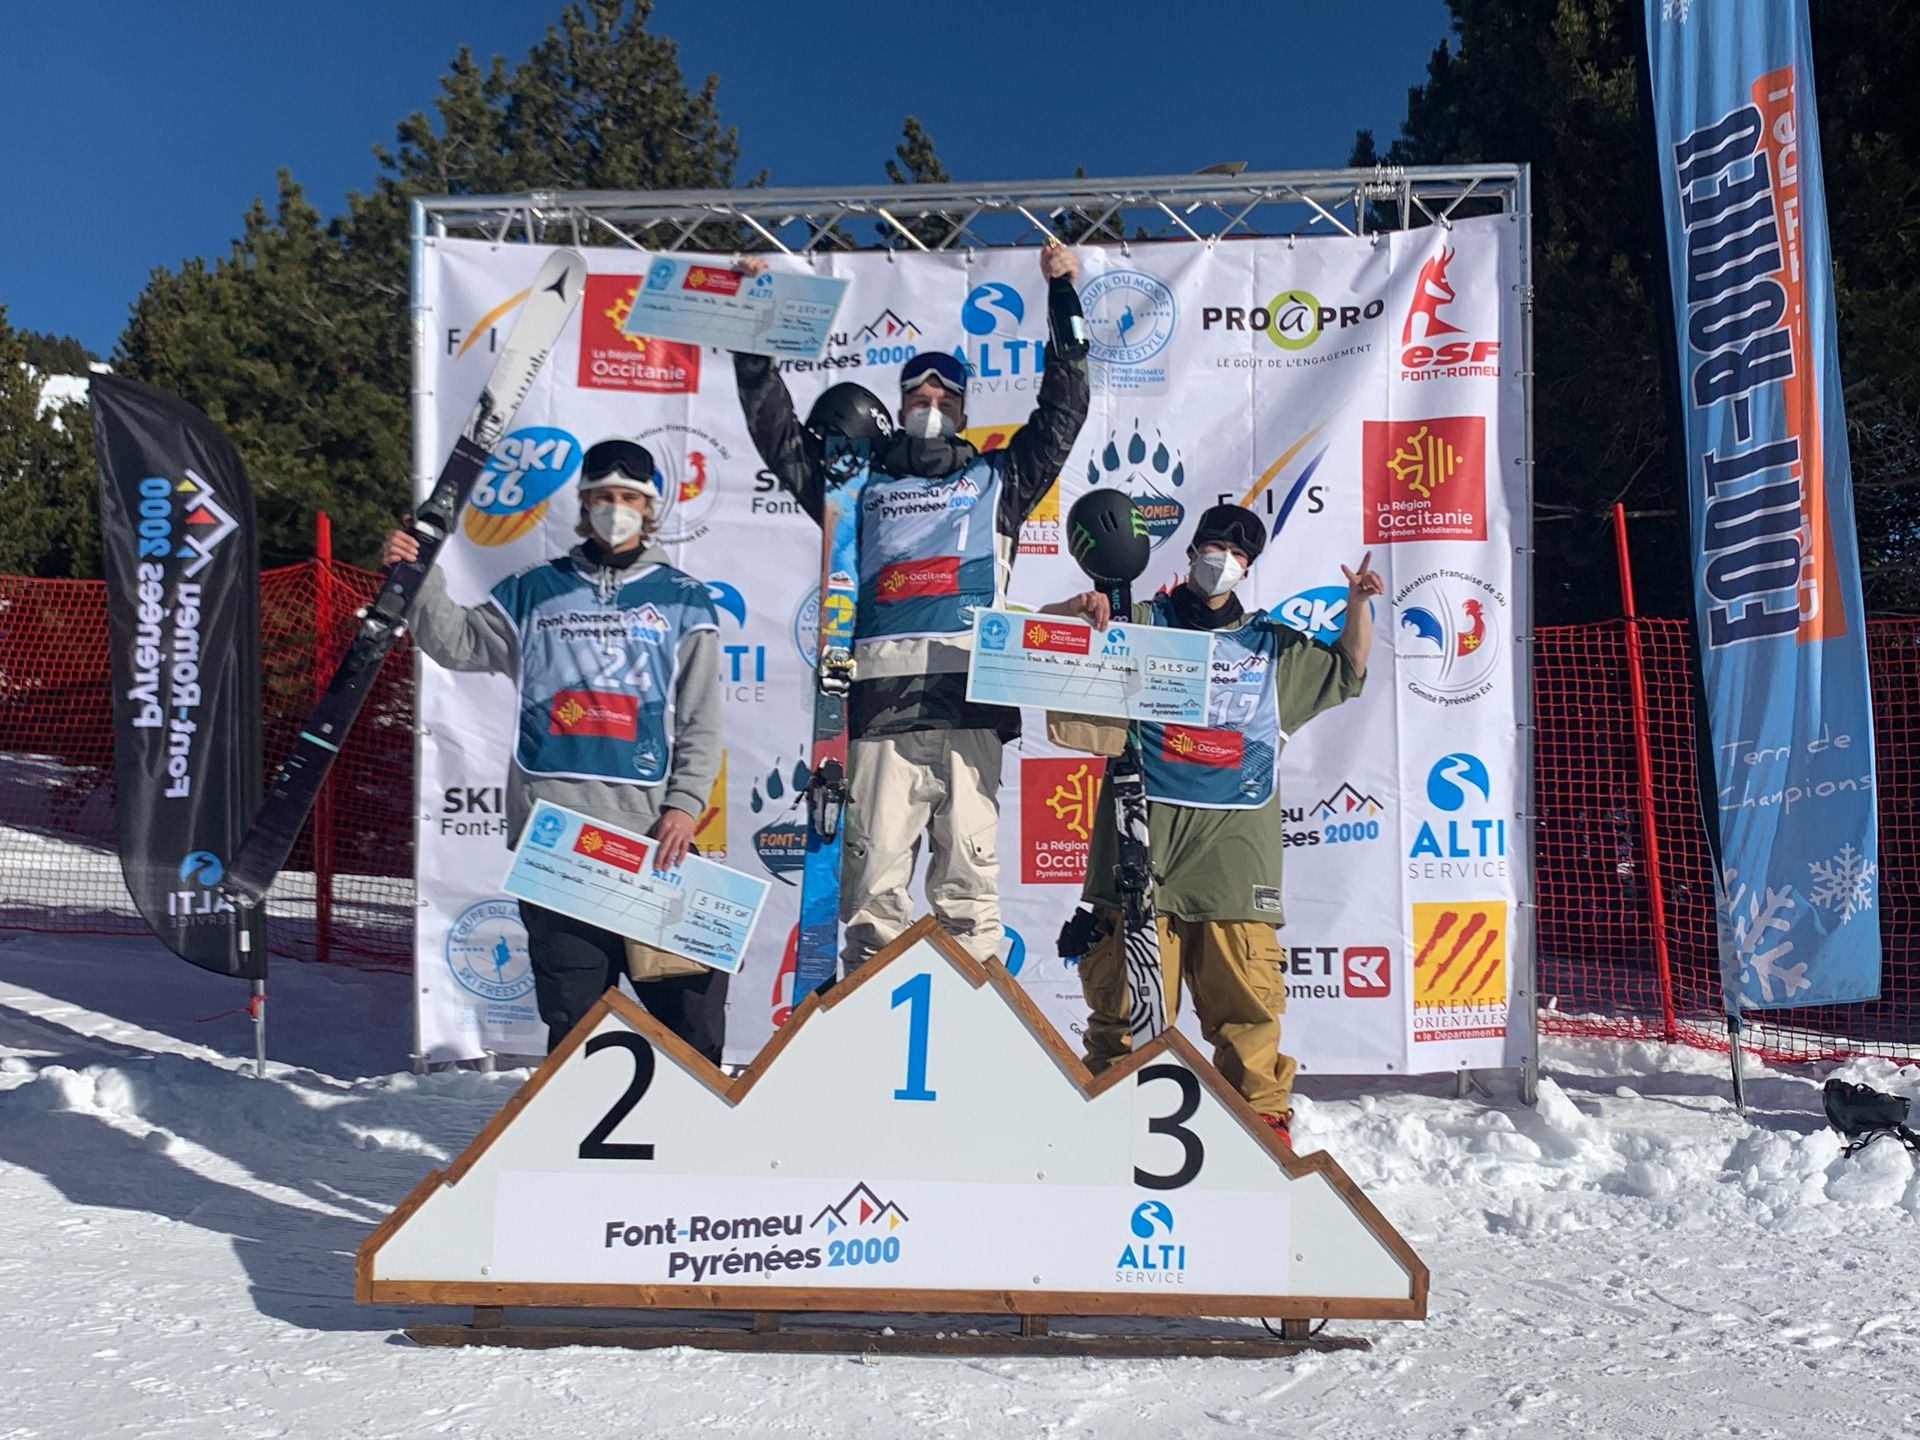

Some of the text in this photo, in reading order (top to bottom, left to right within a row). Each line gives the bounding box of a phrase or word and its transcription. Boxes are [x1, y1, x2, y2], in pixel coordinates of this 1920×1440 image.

[1202, 307, 1271, 331] PRO
[1316, 299, 1385, 331] PRO
[1217, 359, 1230, 368] LE
[1267, 359, 1283, 368] DE
[1286, 344, 1372, 368] L'ENGAGEMENT
[590, 360, 687, 381] Occitanie
[1401, 366, 1501, 382] FONT-ROMEU
[493, 438, 572, 473] SKI
[472, 471, 524, 508] 66
[1377, 499, 1431, 513] La Région
[1378, 507, 1474, 529] Occitanie
[951, 512, 970, 552] 1
[1391, 569, 1508, 608] Fédération Française de Ski
[1050, 633, 1087, 644] Occitanie
[1101, 645, 1130, 657] ALTI
[593, 646, 652, 692] 24
[1480, 681, 1494, 695] Est
[1211, 689, 1261, 727] 17
[1806, 723, 1852, 754] de
[1035, 840, 1089, 852] La Région
[1324, 820, 1379, 845] 2000
[1409, 819, 1505, 859] ALTI
[1408, 860, 1506, 880] SERVICE
[1413, 1014, 1507, 1029] ORIENTALES
[1422, 1028, 1496, 1041] le Département
[890, 973, 938, 1102] 1
[577, 1030, 656, 1160] 2
[1132, 1064, 1205, 1191] 3
[605, 1214, 803, 1248] Font-Romeu
[667, 1236, 901, 1283] Pyrénées 2000
[1116, 1244, 1186, 1272] ALTI
[1115, 1271, 1186, 1285] SERVICE
